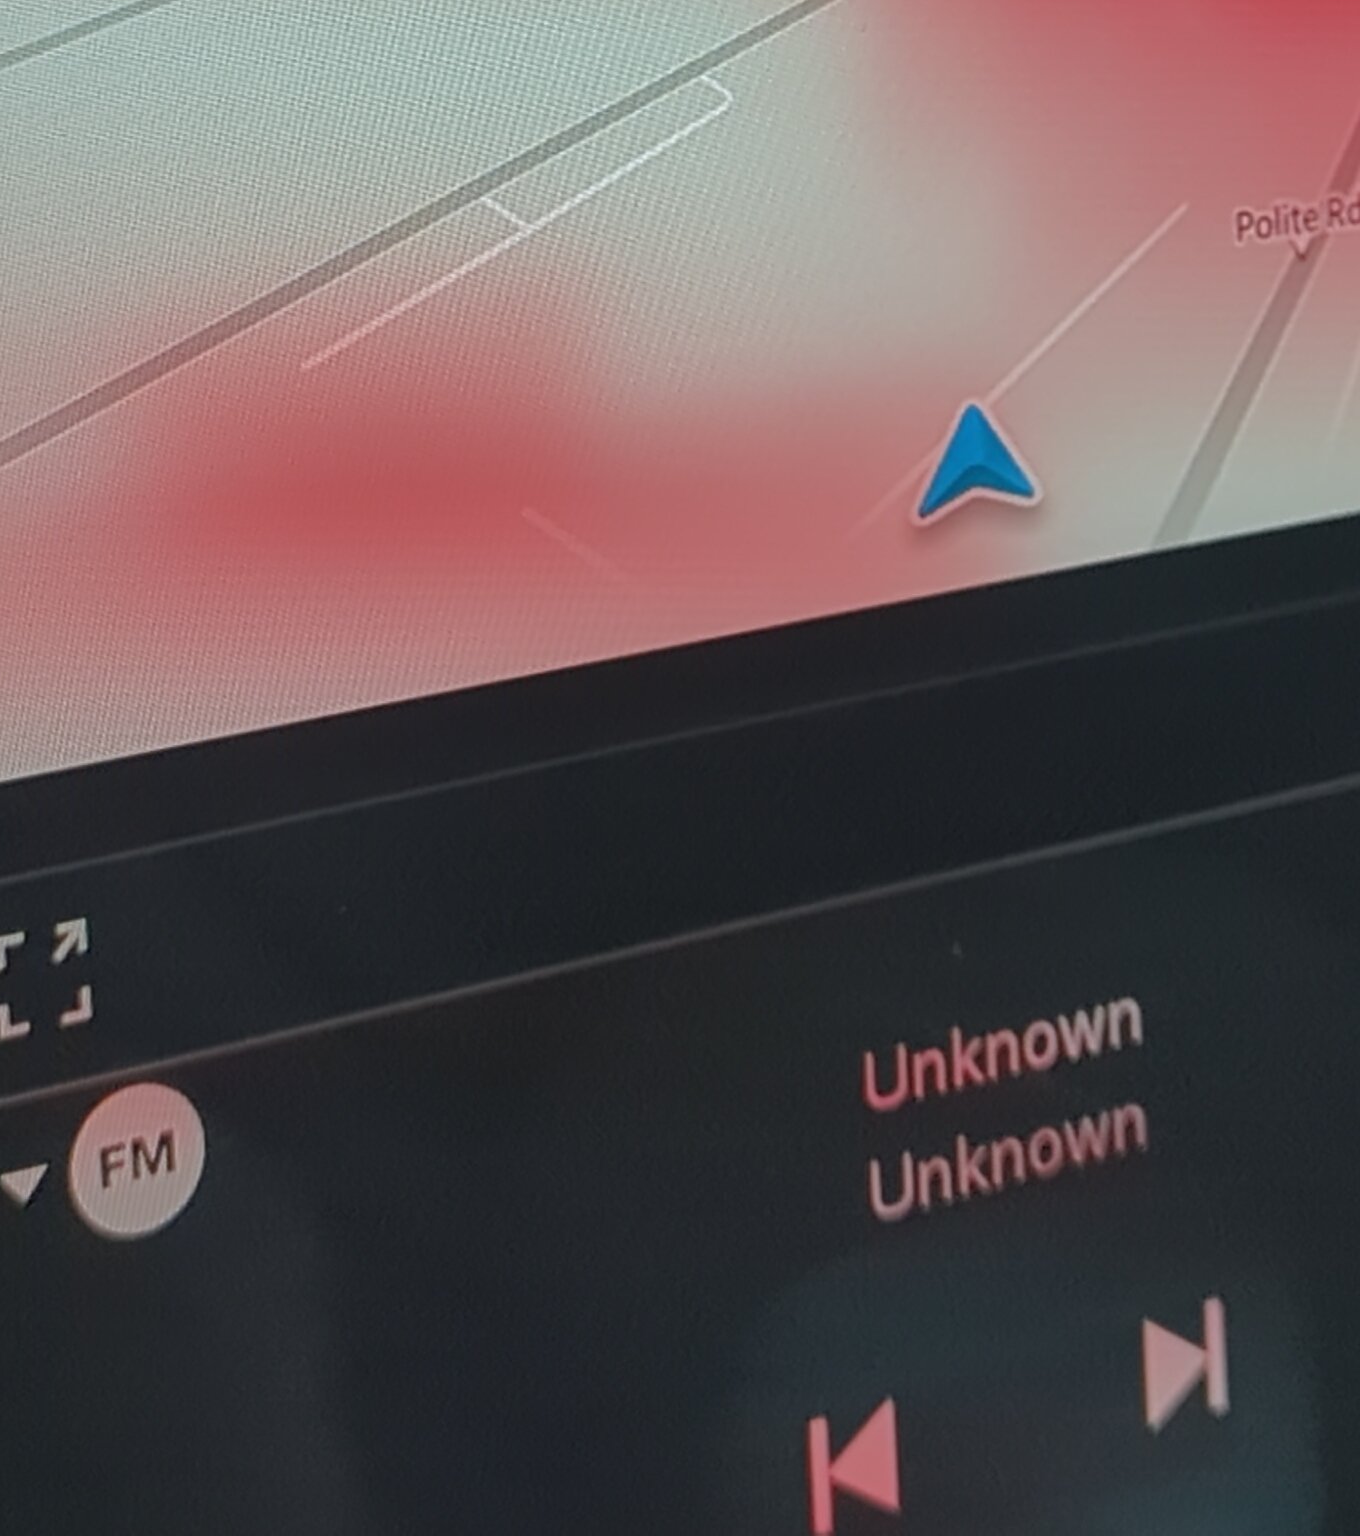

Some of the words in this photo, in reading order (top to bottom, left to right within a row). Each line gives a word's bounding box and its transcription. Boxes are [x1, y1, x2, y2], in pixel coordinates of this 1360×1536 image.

[1236, 204, 1320, 243] Polite
[861, 996, 1143, 1112] Unknown
[99, 1128, 177, 1190] FM
[867, 1102, 1149, 1222] Unknown
